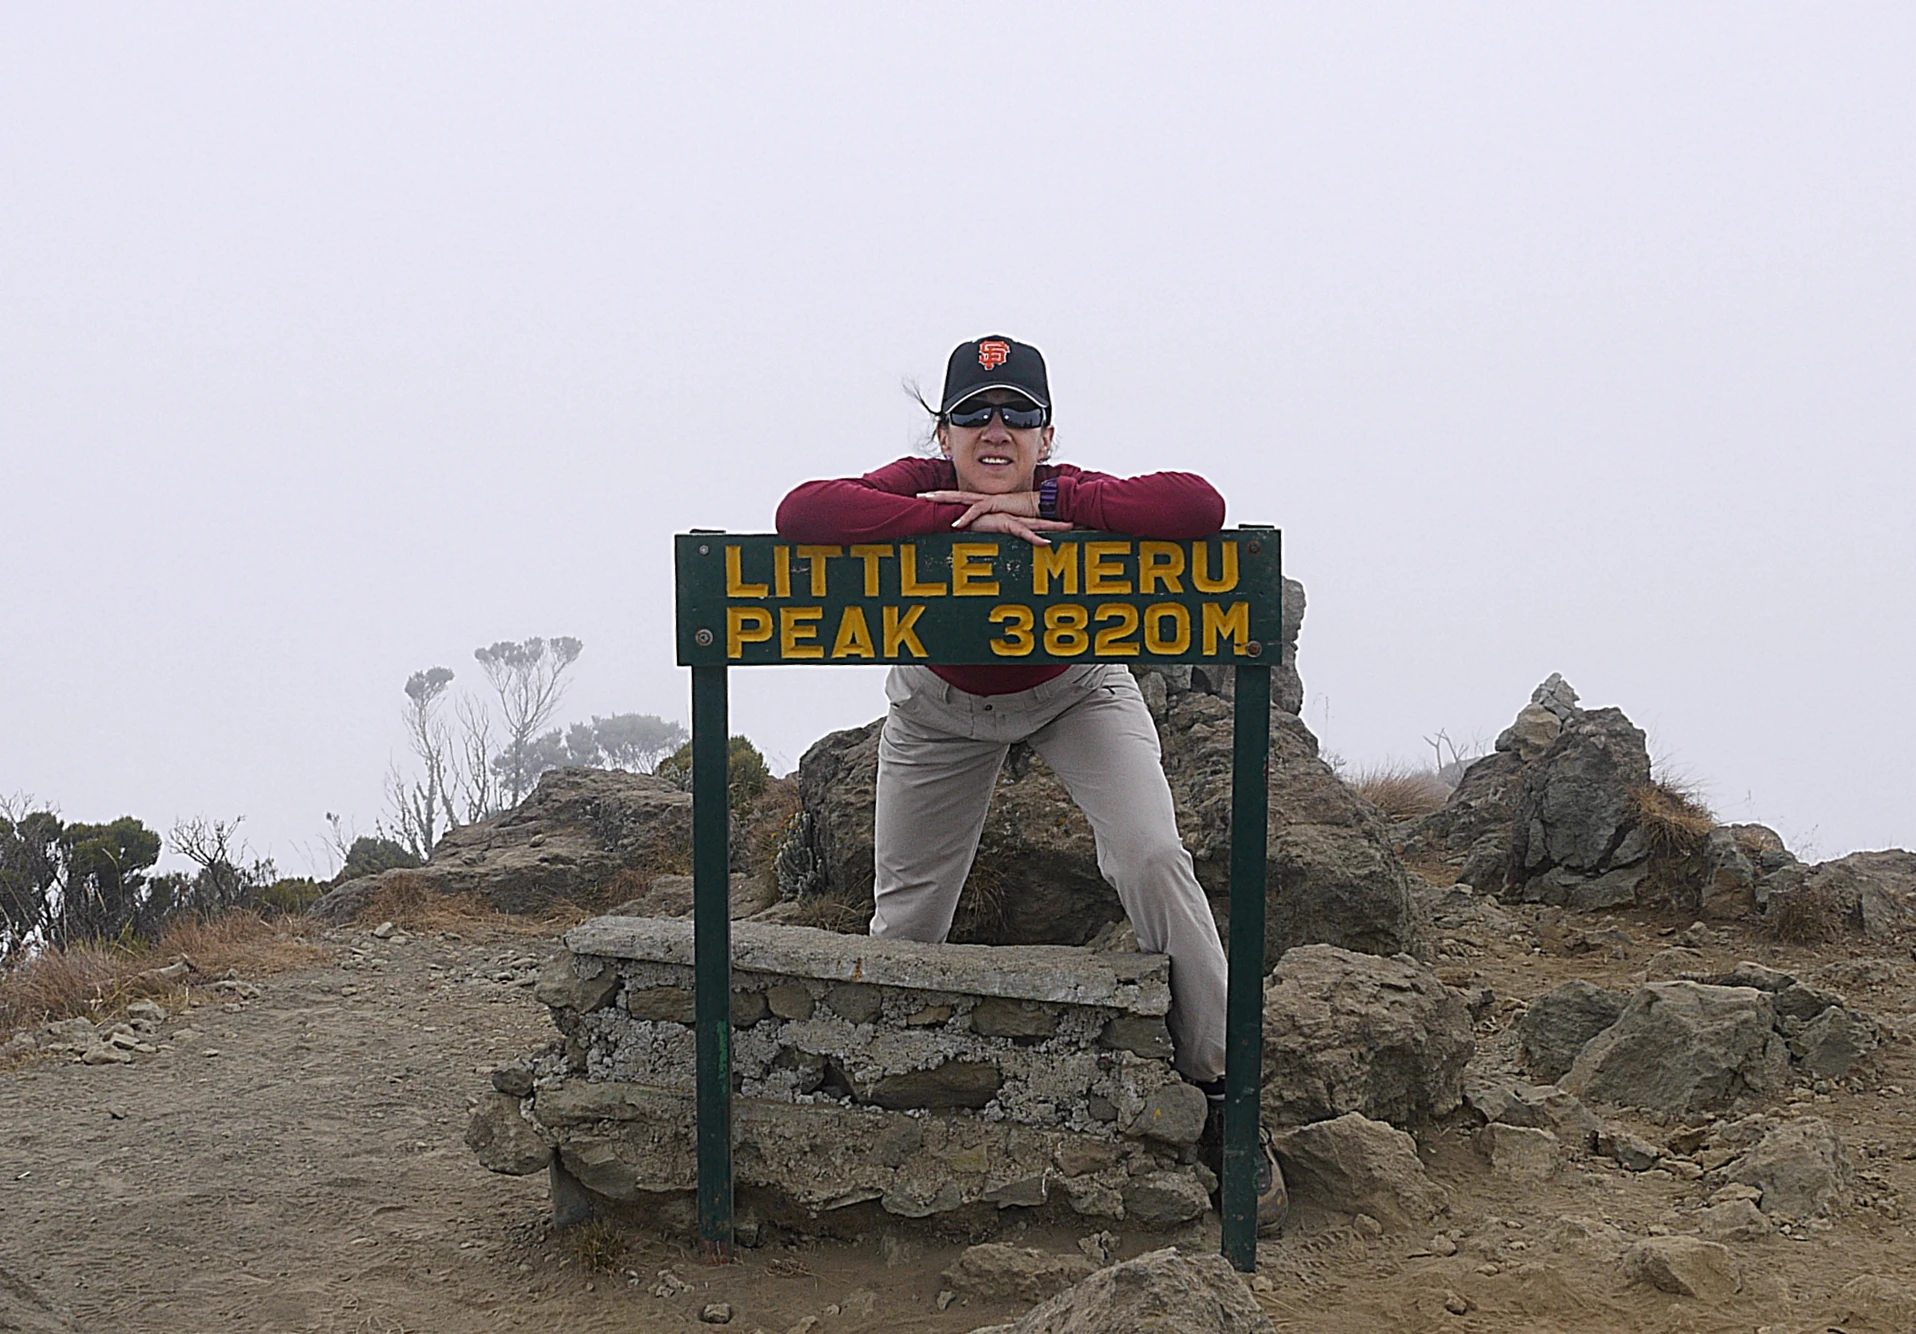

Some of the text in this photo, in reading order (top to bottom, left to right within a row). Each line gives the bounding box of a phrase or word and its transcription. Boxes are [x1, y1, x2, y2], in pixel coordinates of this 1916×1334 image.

[979, 340, 1010, 370] SF
[725, 540, 1240, 598] LITTLE MERU
[726, 601, 1250, 660] PEAK 3820M
